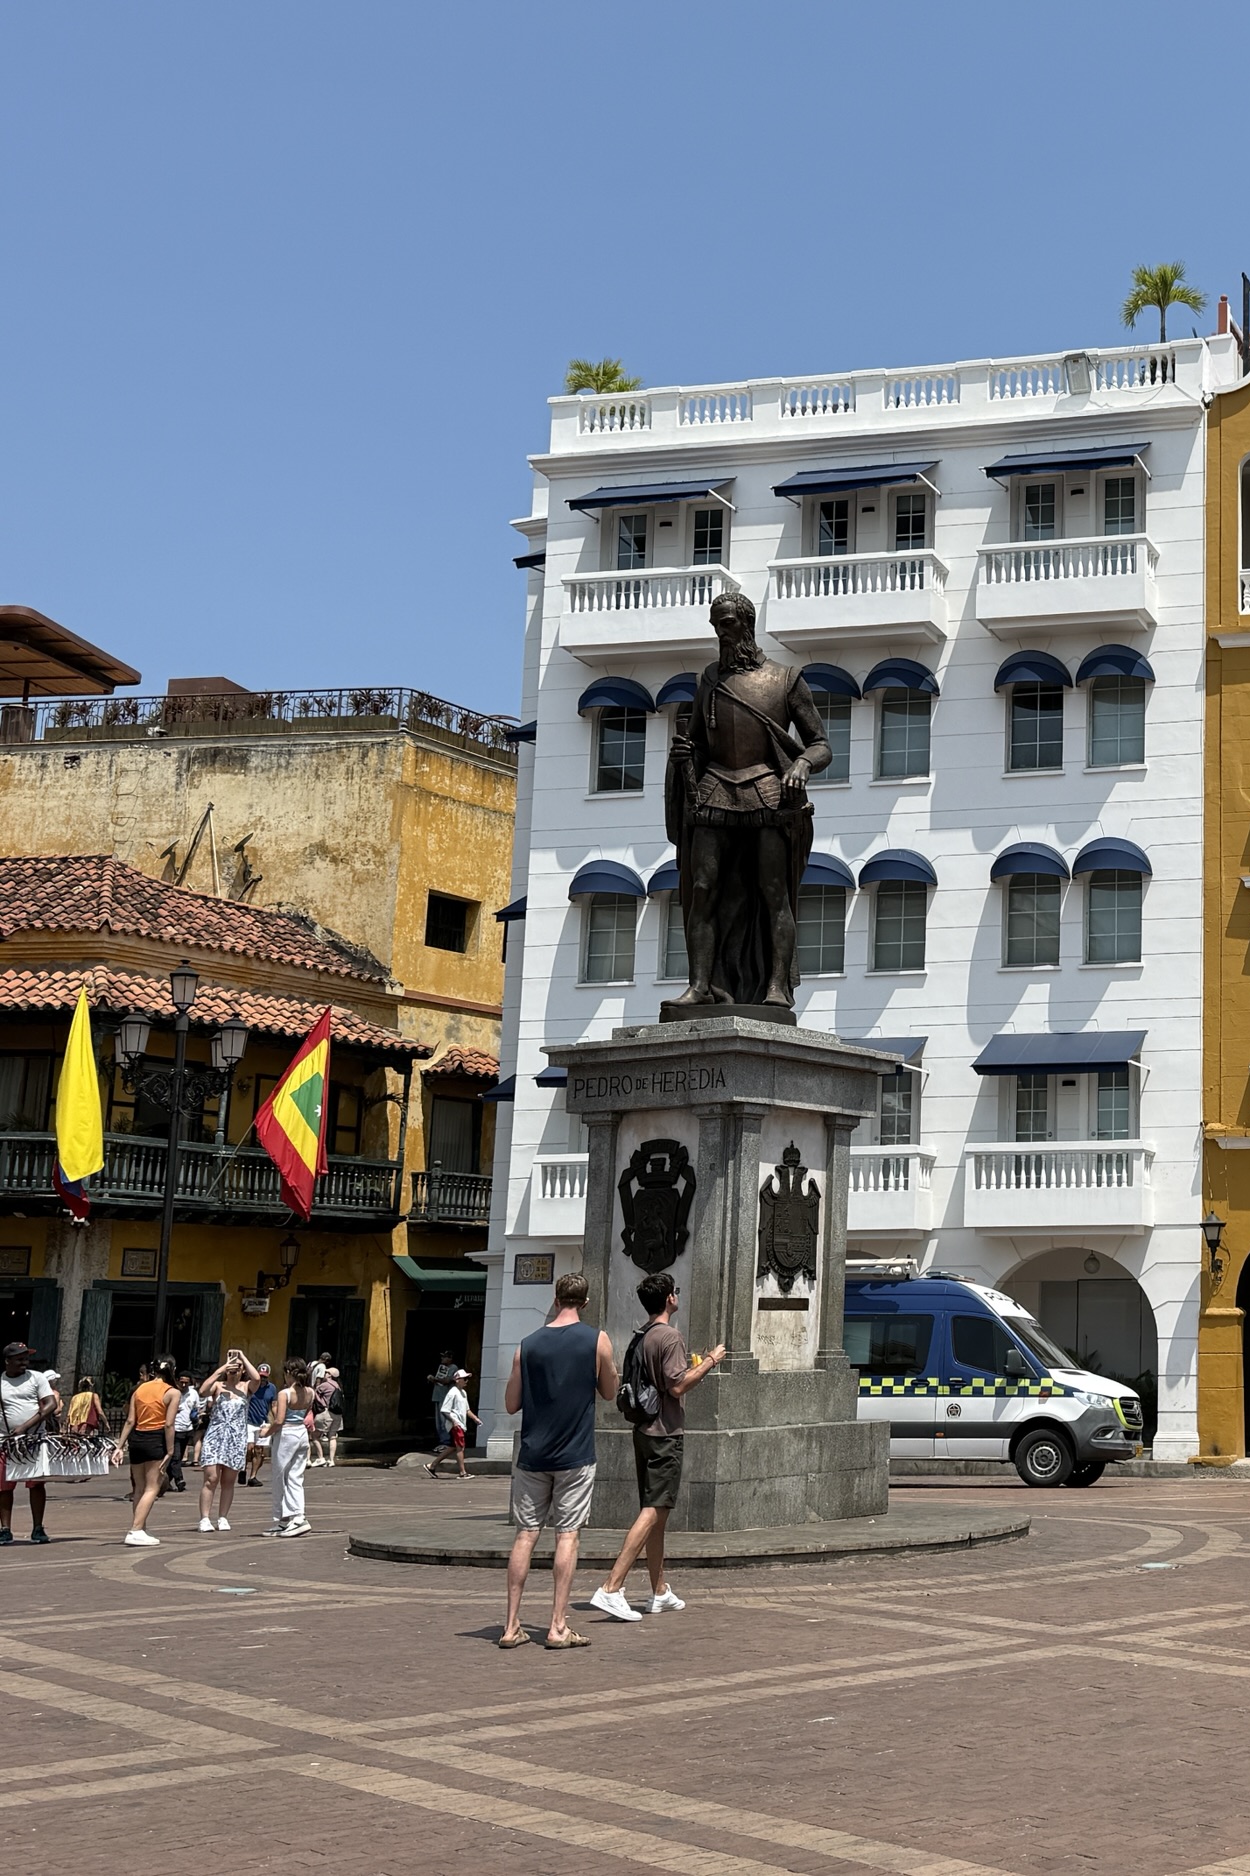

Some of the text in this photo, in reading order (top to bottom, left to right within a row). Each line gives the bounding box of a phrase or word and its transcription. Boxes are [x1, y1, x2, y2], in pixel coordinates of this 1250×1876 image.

[573, 1068, 726, 1099] PEDRO DE HEREDIA
